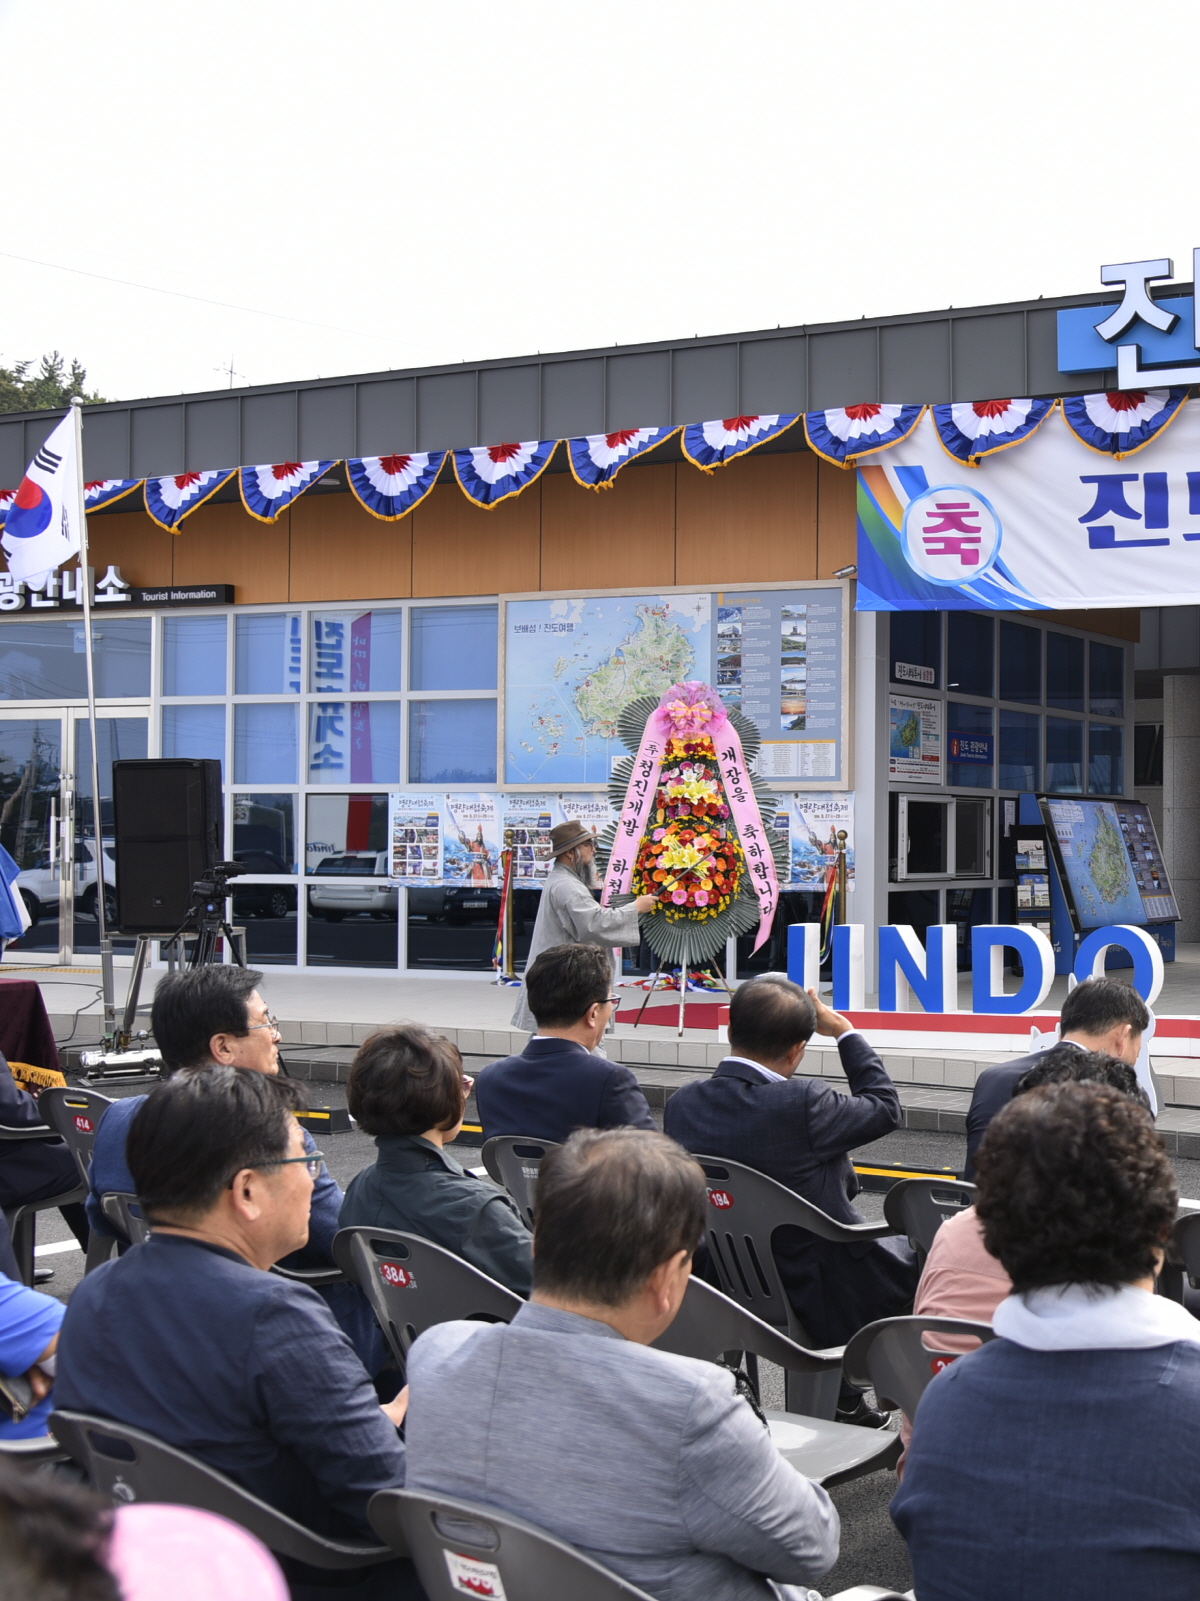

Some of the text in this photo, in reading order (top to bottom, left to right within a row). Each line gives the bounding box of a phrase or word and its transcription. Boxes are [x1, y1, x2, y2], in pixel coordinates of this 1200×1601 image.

[922, 502, 982, 567] 축
[141, 589, 217, 602] Tourist Information
[514, 624, 536, 633] 보배섬
[544, 622, 574, 633] 진도여행
[450, 803, 494, 813] 명량대첩축제
[800, 802, 849, 814] 명량대첩축제
[721, 747, 774, 916] 개장을 축하합니다
[603, 858, 629, 909] 하철
[76, 1117, 90, 1130] 414
[712, 1193, 730, 1206] 194
[384, 1265, 406, 1284] 384
